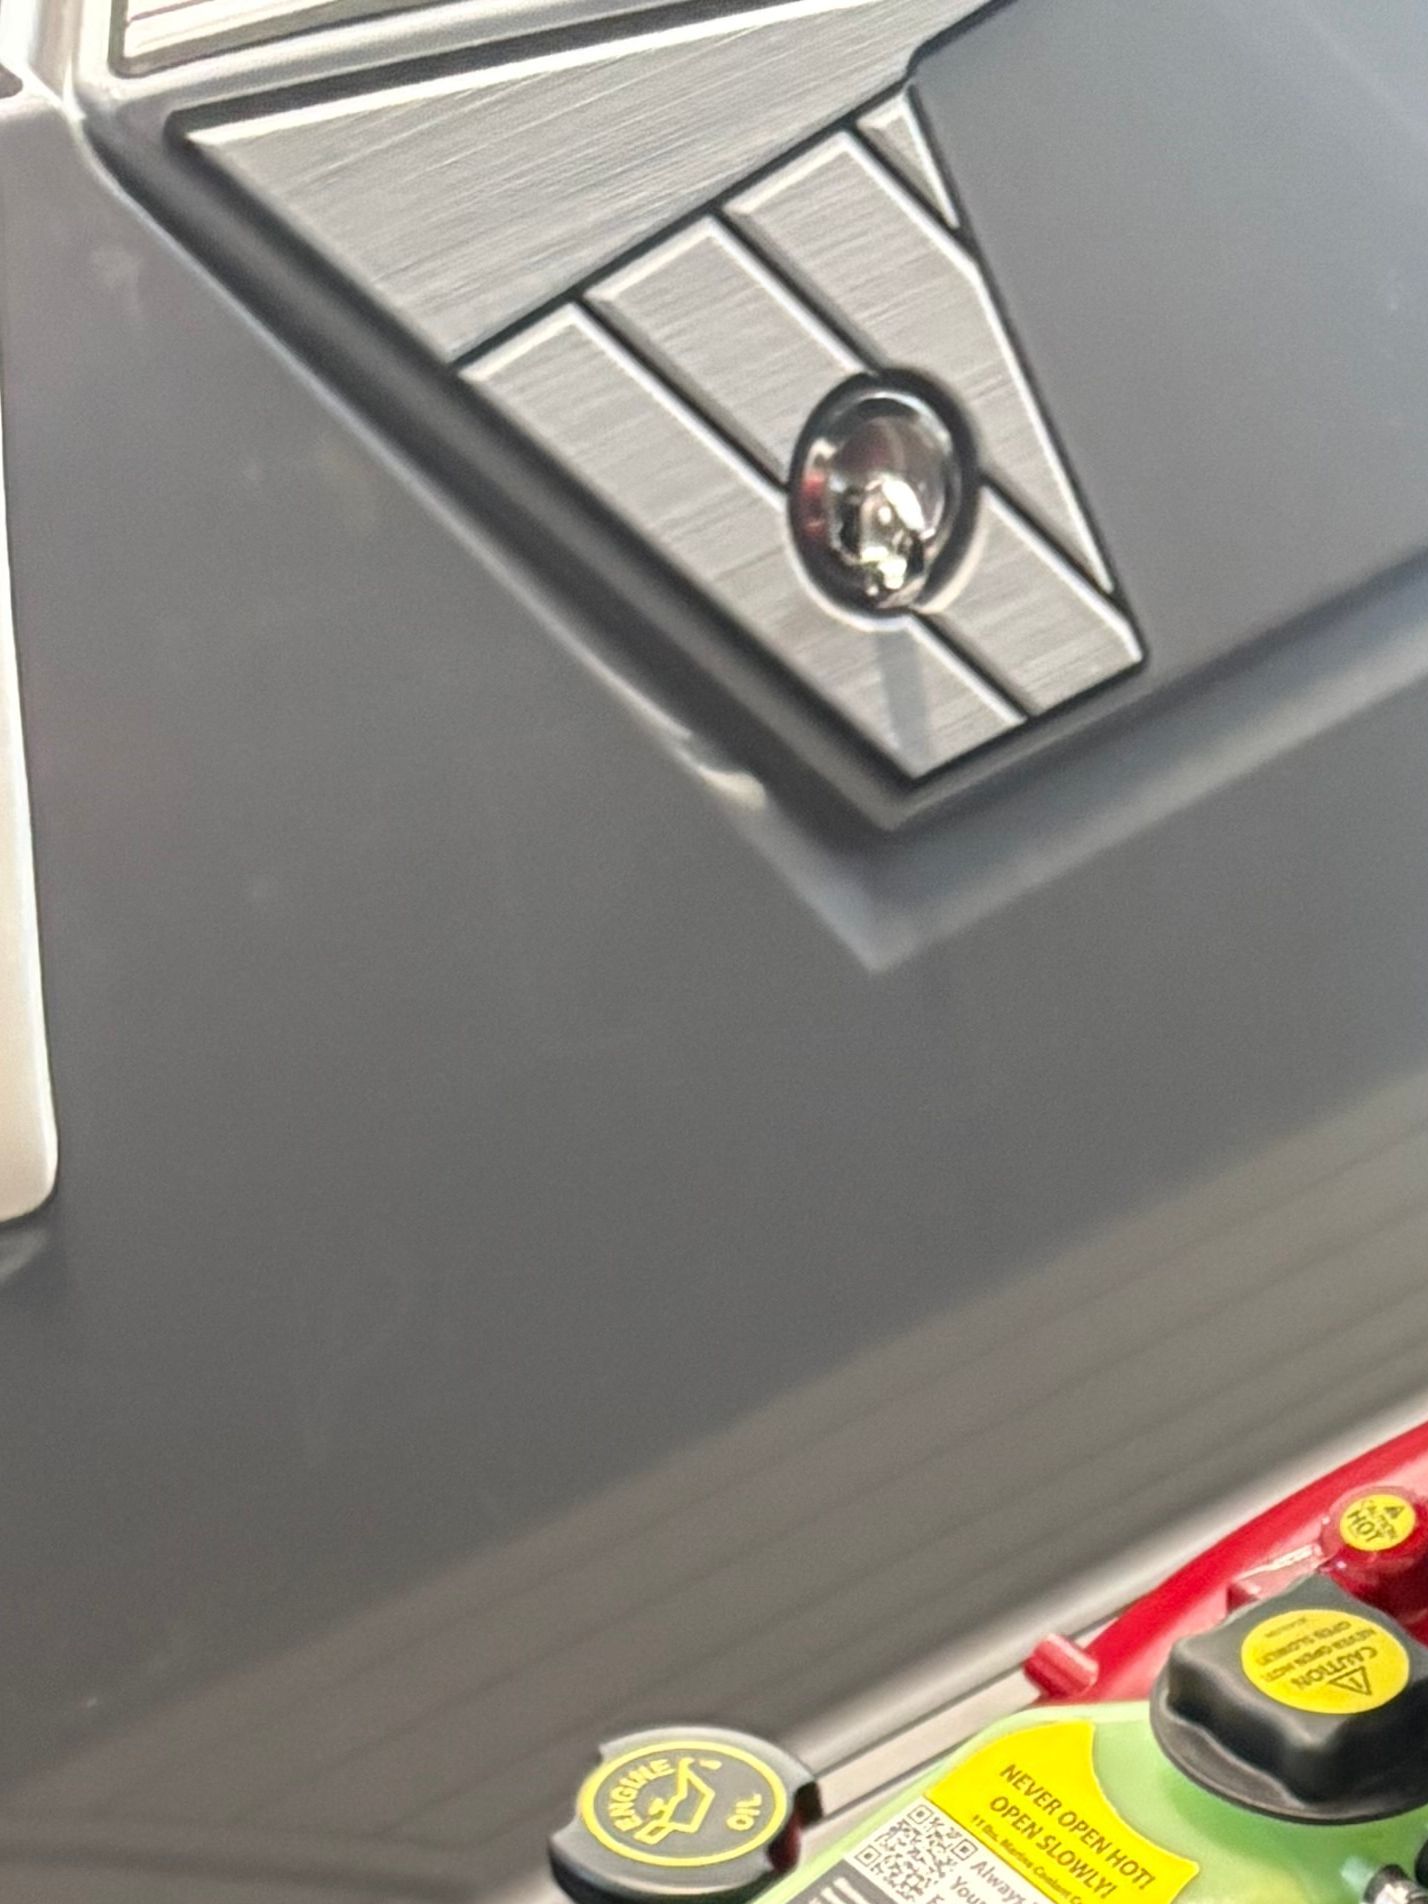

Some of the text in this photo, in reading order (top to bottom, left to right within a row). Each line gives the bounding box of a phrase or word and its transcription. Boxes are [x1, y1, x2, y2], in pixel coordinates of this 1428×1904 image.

[1347, 1510, 1381, 1542] HOT
[1291, 1647, 1377, 1688] CAUTION
[609, 1759, 761, 1831] ENGINE OIL
[998, 1763, 1156, 1890] NEVER OPEN HOT!
[987, 1794, 1117, 1899] OPEN SLOWLY!
